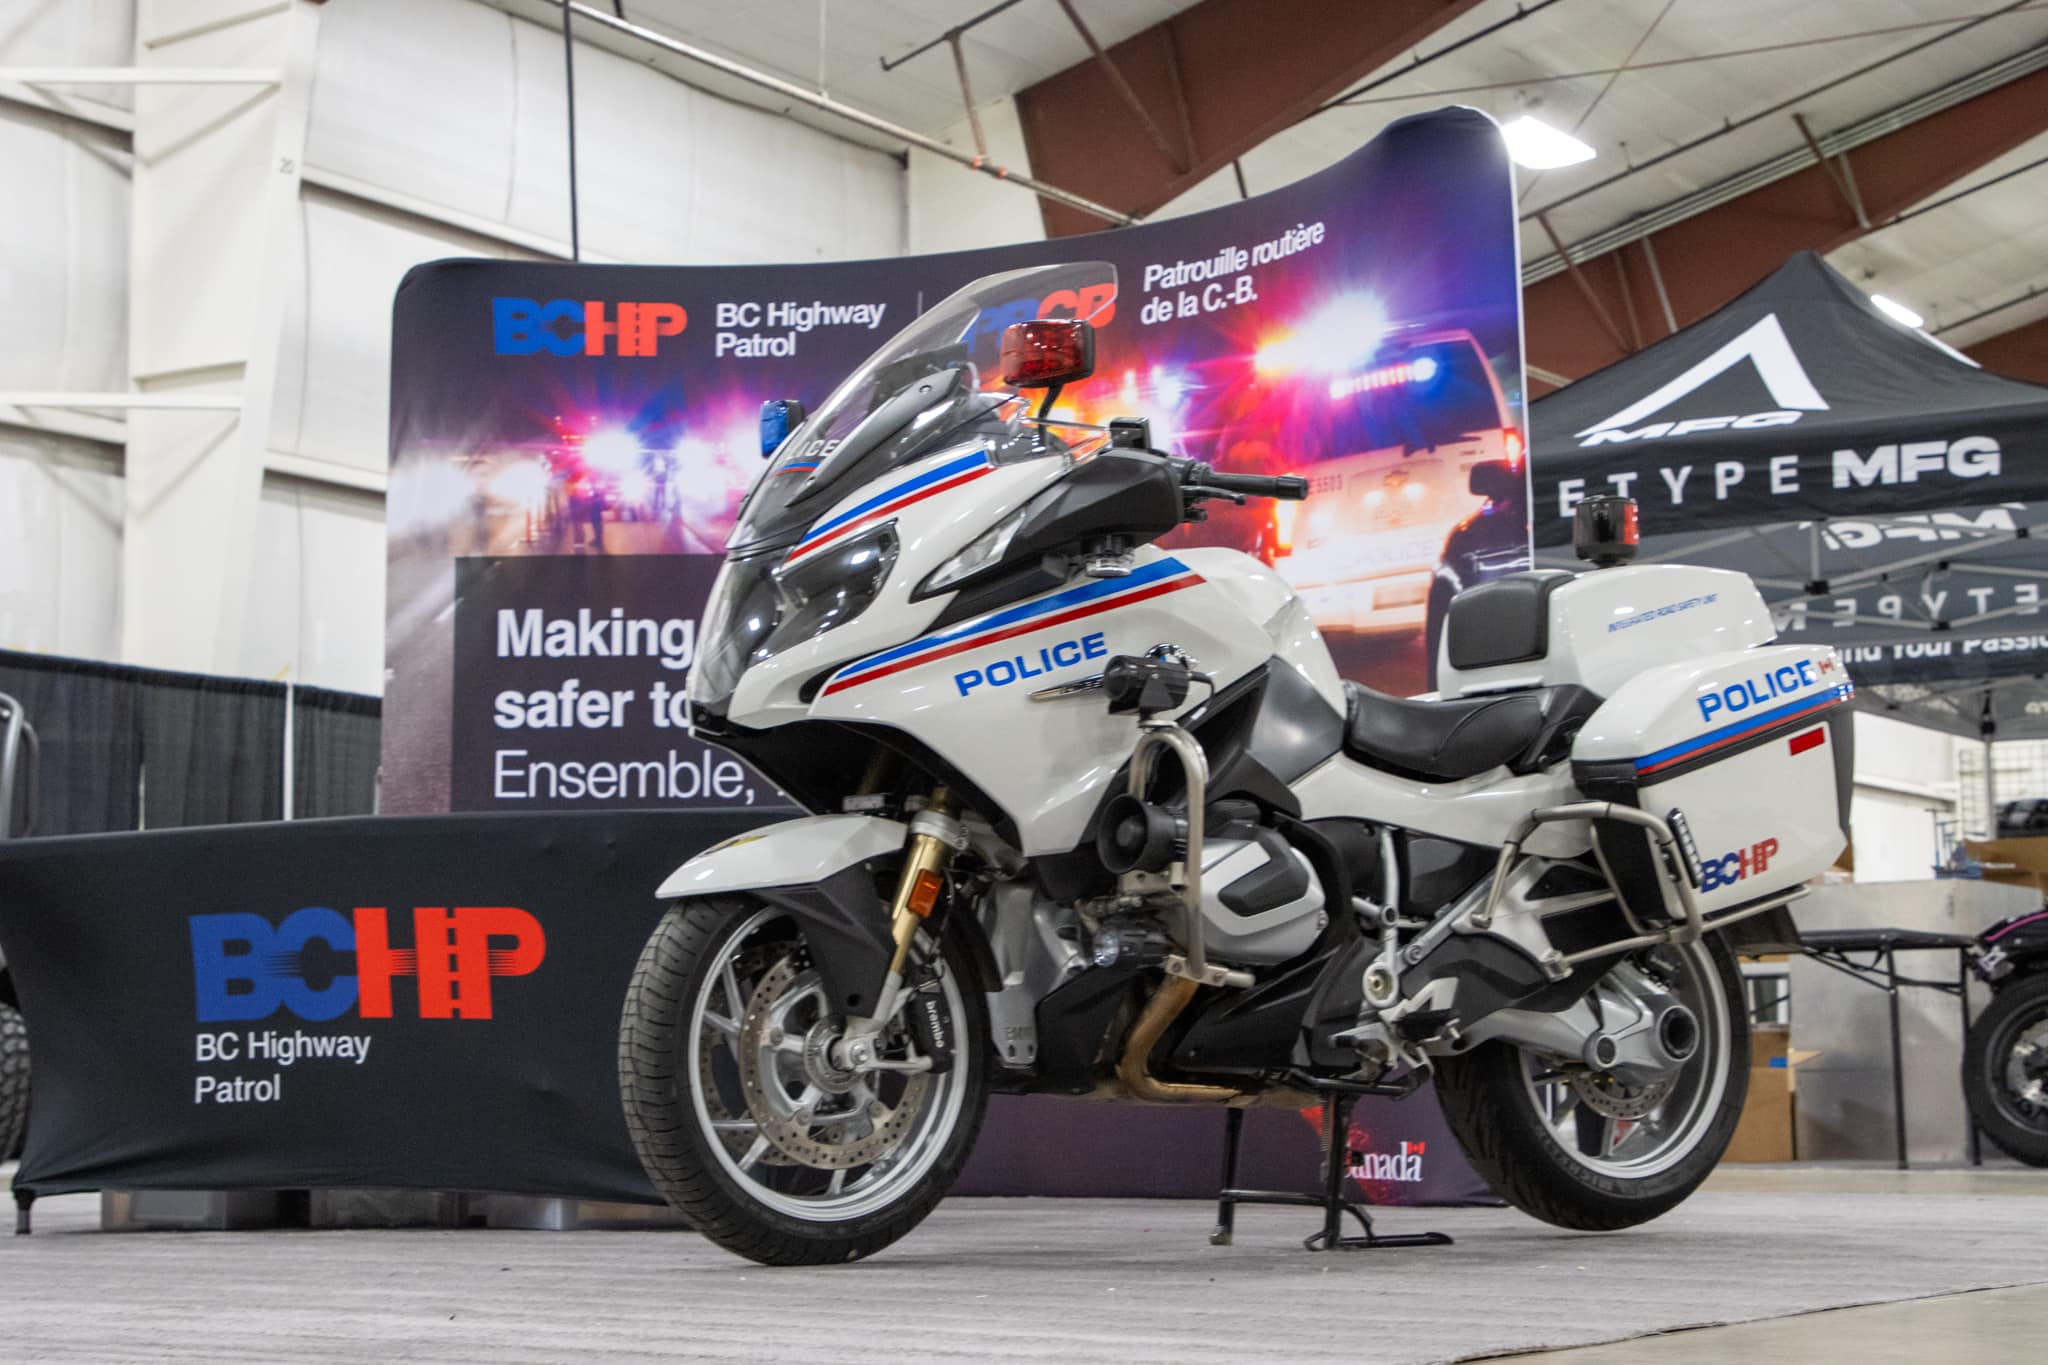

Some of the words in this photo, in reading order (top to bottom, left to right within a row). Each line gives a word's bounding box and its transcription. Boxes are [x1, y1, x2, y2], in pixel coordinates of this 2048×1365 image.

[1143, 246, 1249, 292] Patrouille
[1251, 221, 1326, 267] routière
[716, 303, 761, 328] BC
[767, 301, 887, 331] Highway
[1140, 296, 1174, 325] de
[1177, 291, 1199, 318] la
[1202, 274, 1259, 312] C.-B.
[493, 297, 688, 357] BCHP
[716, 332, 797, 358] Patrol
[1578, 410, 1803, 447] MFG
[1832, 435, 2001, 489] MFG
[496, 607, 695, 670] Making
[954, 631, 1109, 697] POLICE
[493, 678, 635, 729] safer
[1697, 658, 1819, 723] POLICE
[494, 749, 755, 804] Ensemble,
[1701, 837, 1779, 893] BCHP
[189, 906, 547, 1023] BCHP
[196, 1032, 240, 1062] BC
[248, 1030, 371, 1066] Highway
[195, 1074, 281, 1104] Patrol
[1345, 1141, 1423, 1182] nada
